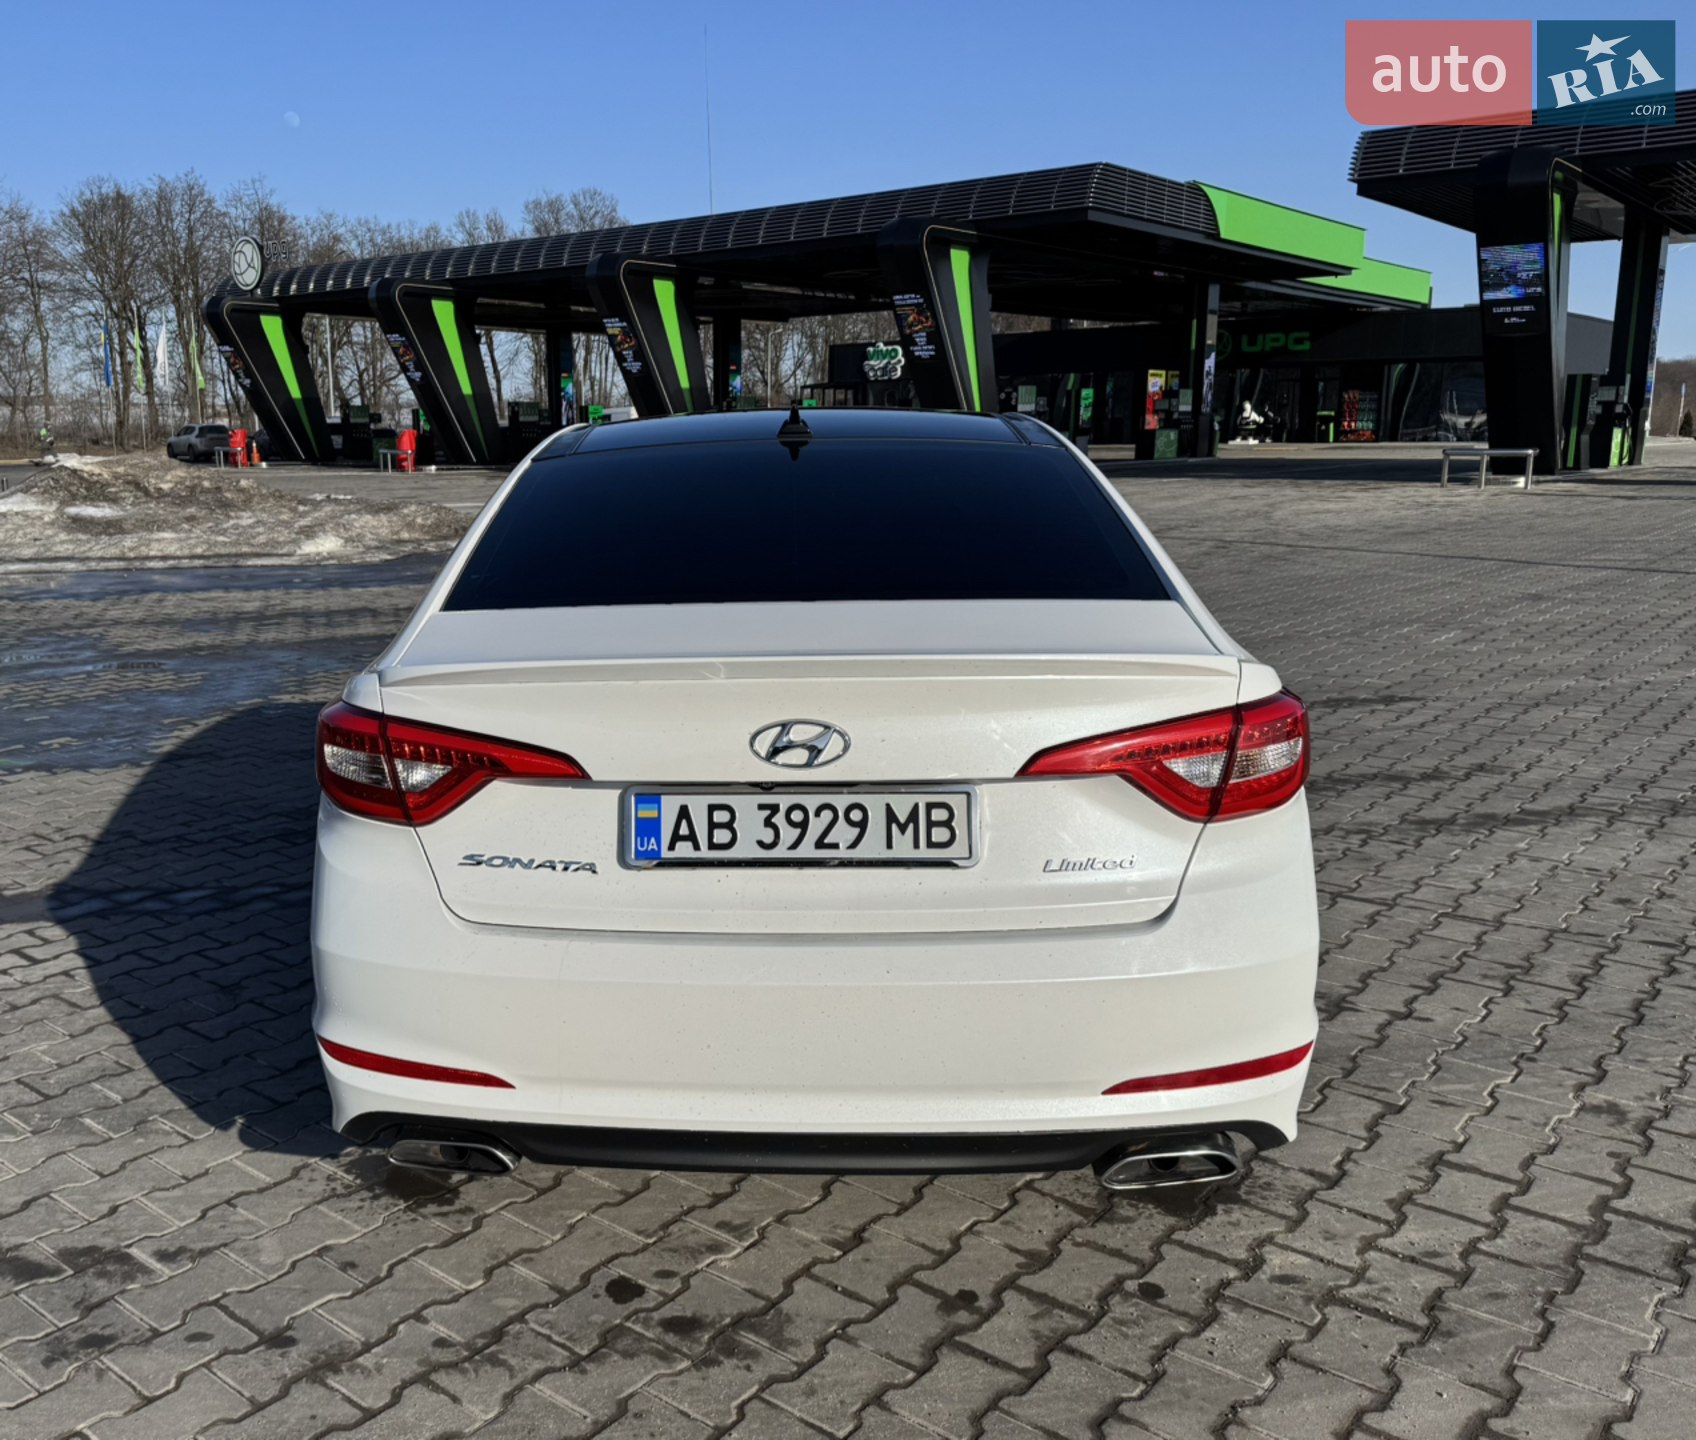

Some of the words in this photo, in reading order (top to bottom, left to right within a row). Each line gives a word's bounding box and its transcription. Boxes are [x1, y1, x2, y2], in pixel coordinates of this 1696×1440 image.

[867, 342, 902, 362] vivo
[1242, 332, 1310, 352] UPG
[667, 803, 739, 851] AB
[755, 802, 871, 851] 3929
[886, 801, 957, 849] MB
[637, 837, 658, 850] UA
[457, 853, 598, 875] SONATA
[1042, 855, 1136, 873] Limited
